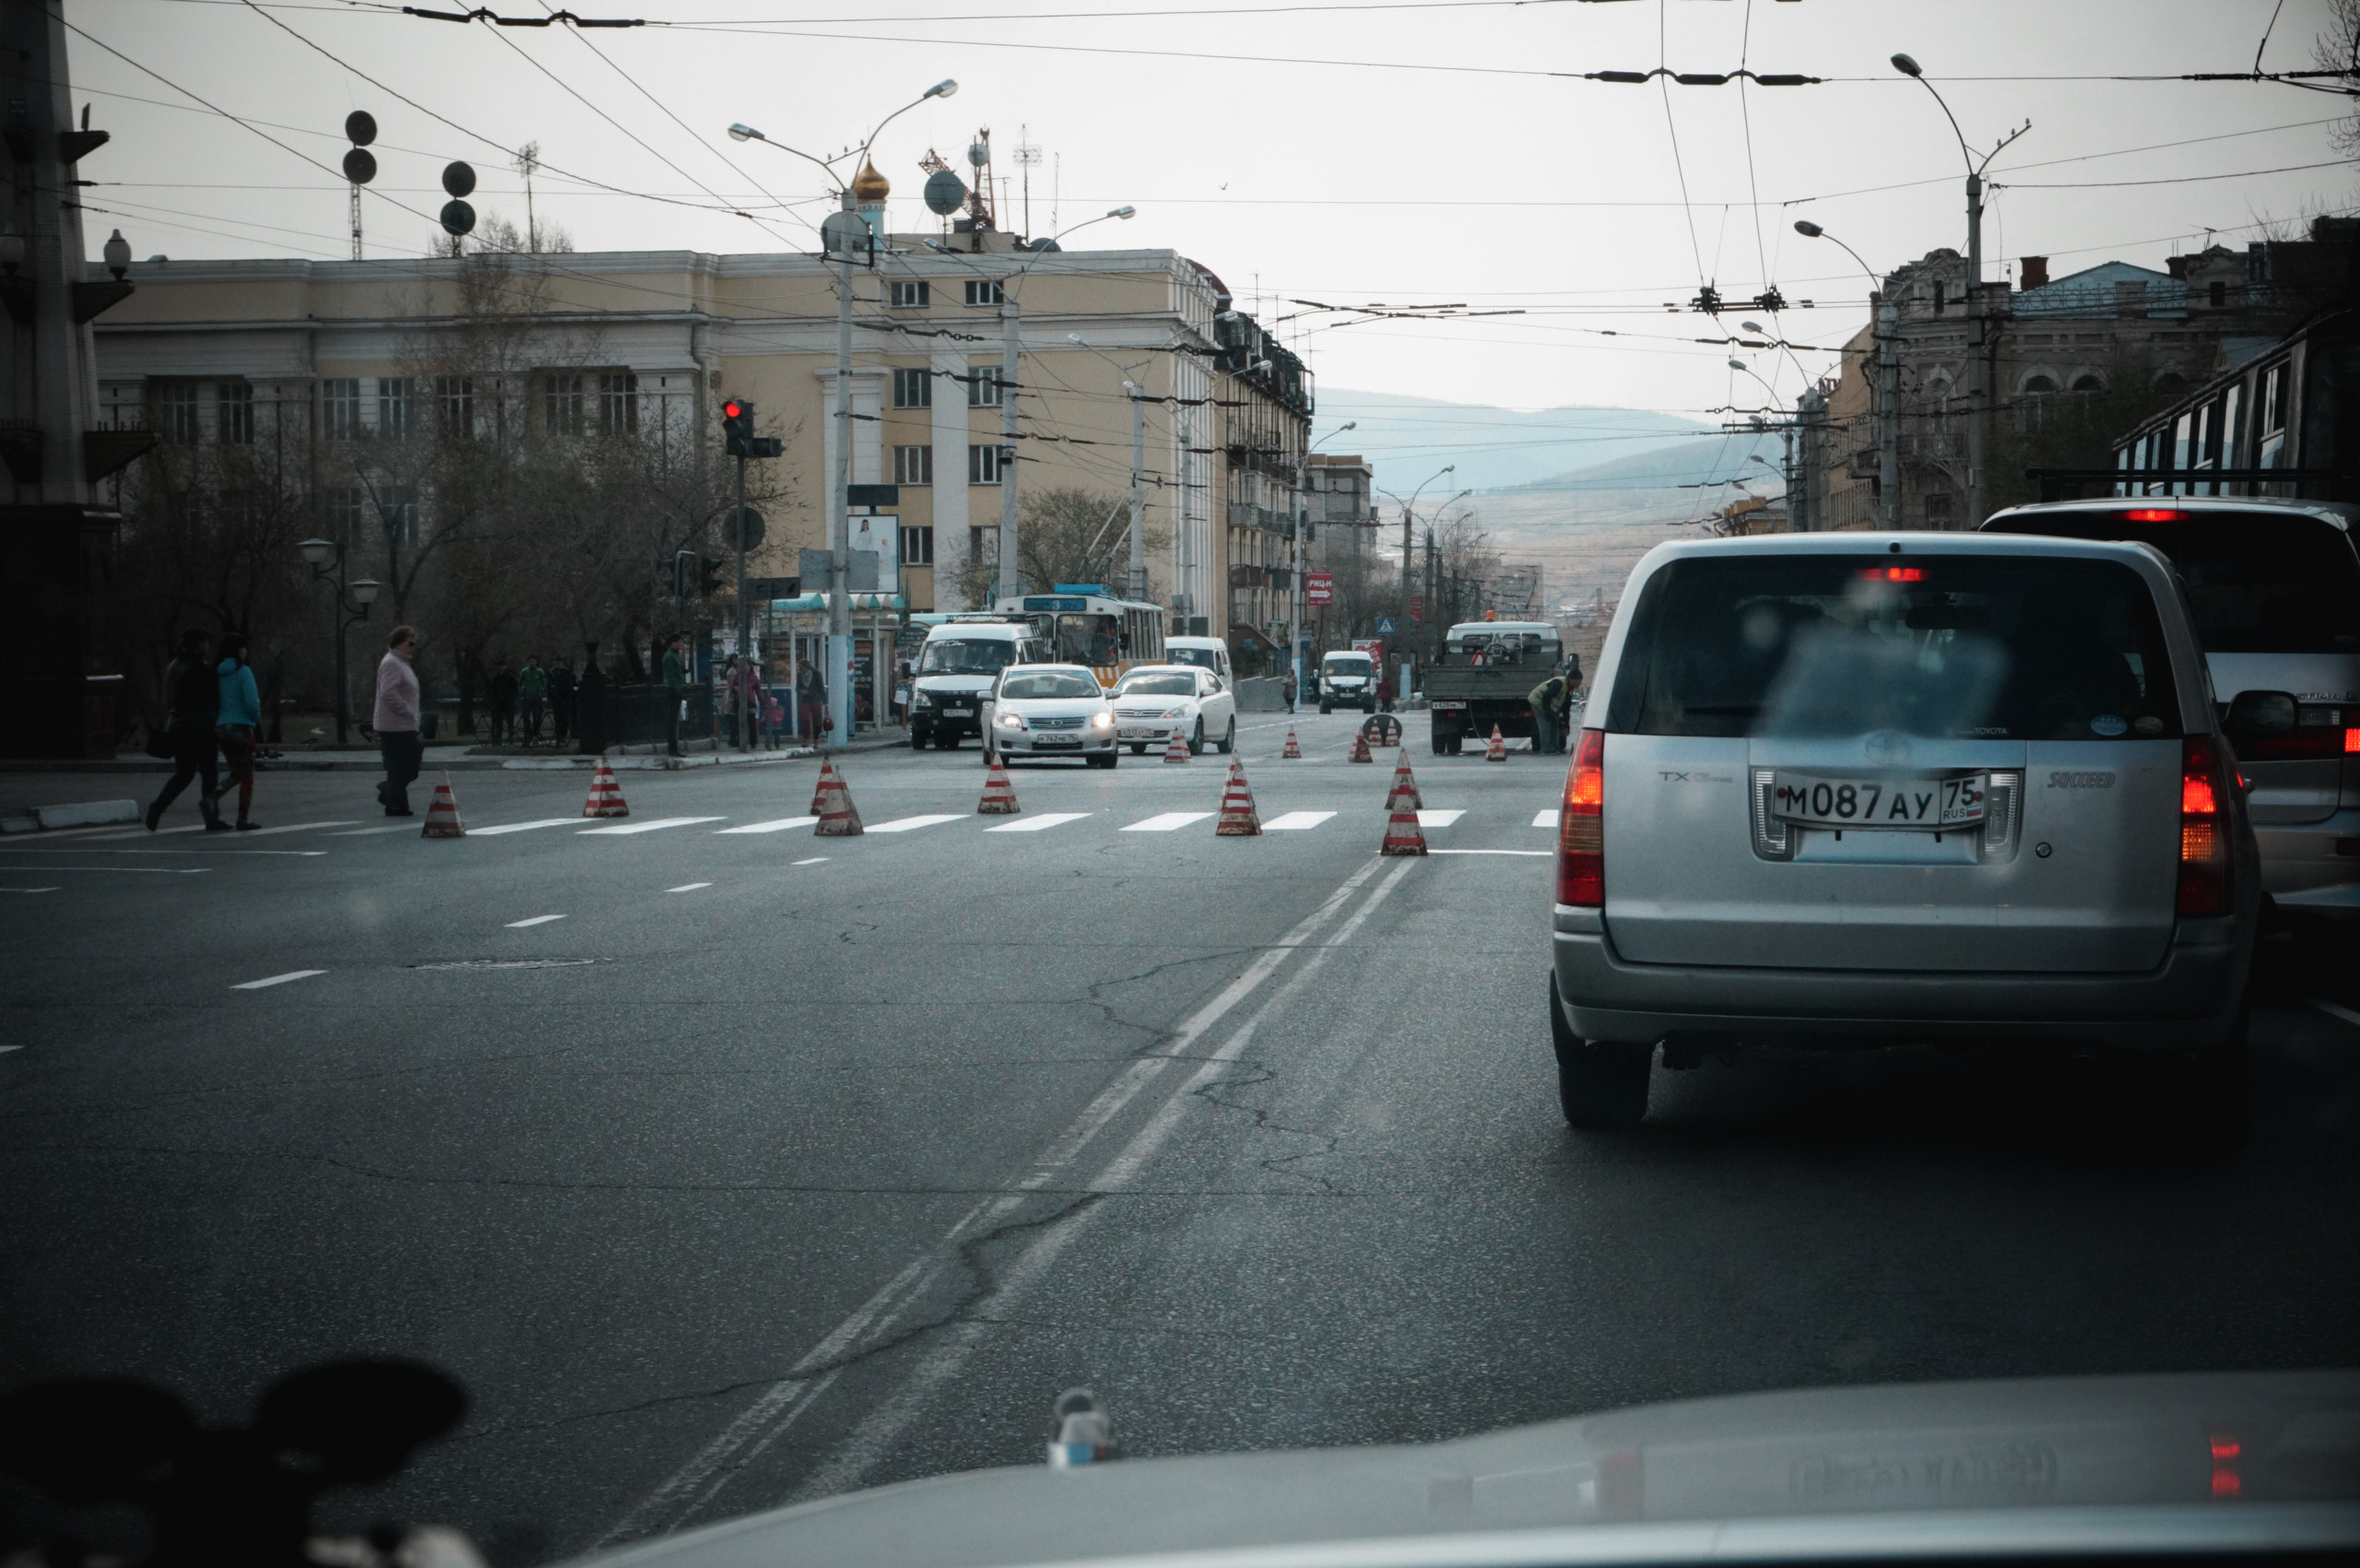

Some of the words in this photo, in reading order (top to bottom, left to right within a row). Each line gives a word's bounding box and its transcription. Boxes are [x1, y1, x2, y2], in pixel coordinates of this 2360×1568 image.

[1052, 600, 1060, 610] 3
[2295, 692, 2341, 701] STIMA
[1658, 772, 1690, 782] TX
[2047, 772, 2116, 788] SUCCEED
[1945, 779, 1976, 809] 75
[1943, 808, 1966, 819] RUS
